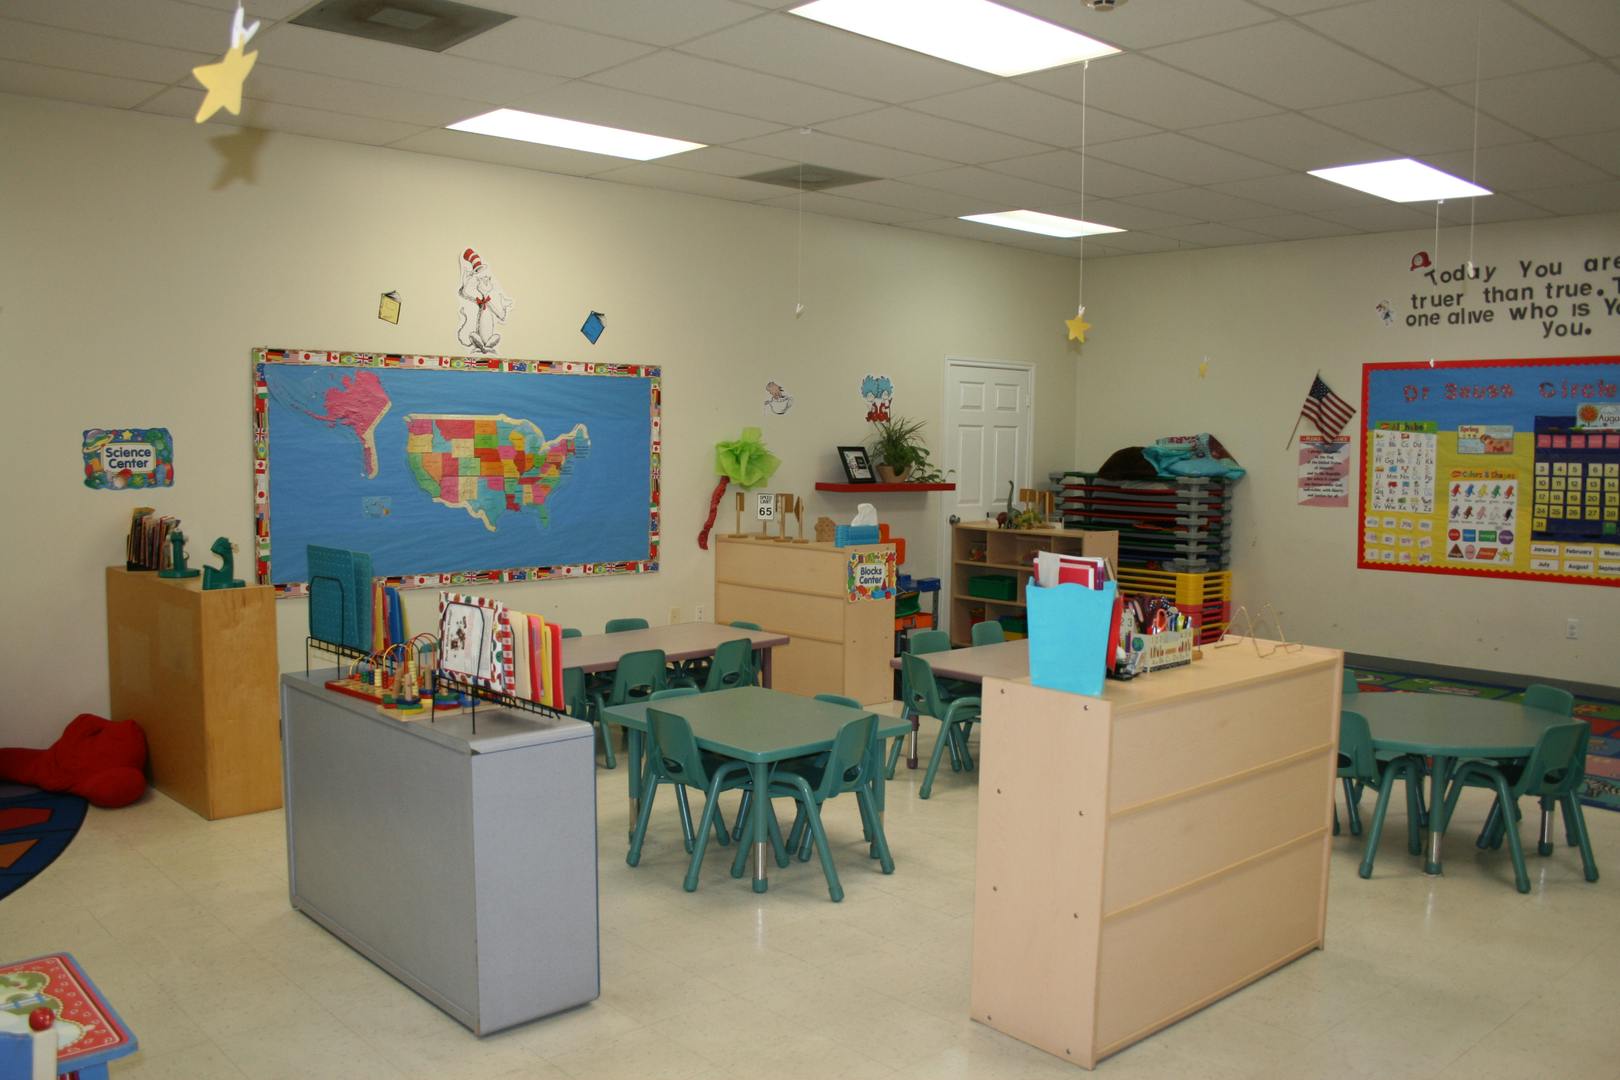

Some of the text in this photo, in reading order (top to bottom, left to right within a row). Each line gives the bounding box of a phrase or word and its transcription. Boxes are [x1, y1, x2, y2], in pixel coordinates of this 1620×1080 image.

[1424, 263, 1497, 286] Today
[1519, 260, 1563, 278] You
[1411, 292, 1465, 309] truer
[1483, 286, 1534, 303] than
[1405, 312, 1440, 327] one
[1448, 308, 1495, 325] alive
[1509, 302, 1559, 321] who
[1571, 302, 1591, 317] is
[1444, 383, 1515, 400] Seuss
[1538, 378, 1618, 399] Circle
[105, 446, 151, 458] Science
[108, 458, 149, 469] Center
[759, 506, 772, 516] 65
[1533, 546, 1557, 554] January
[860, 566, 882, 575] Blocks
[859, 575, 882, 584] Center
